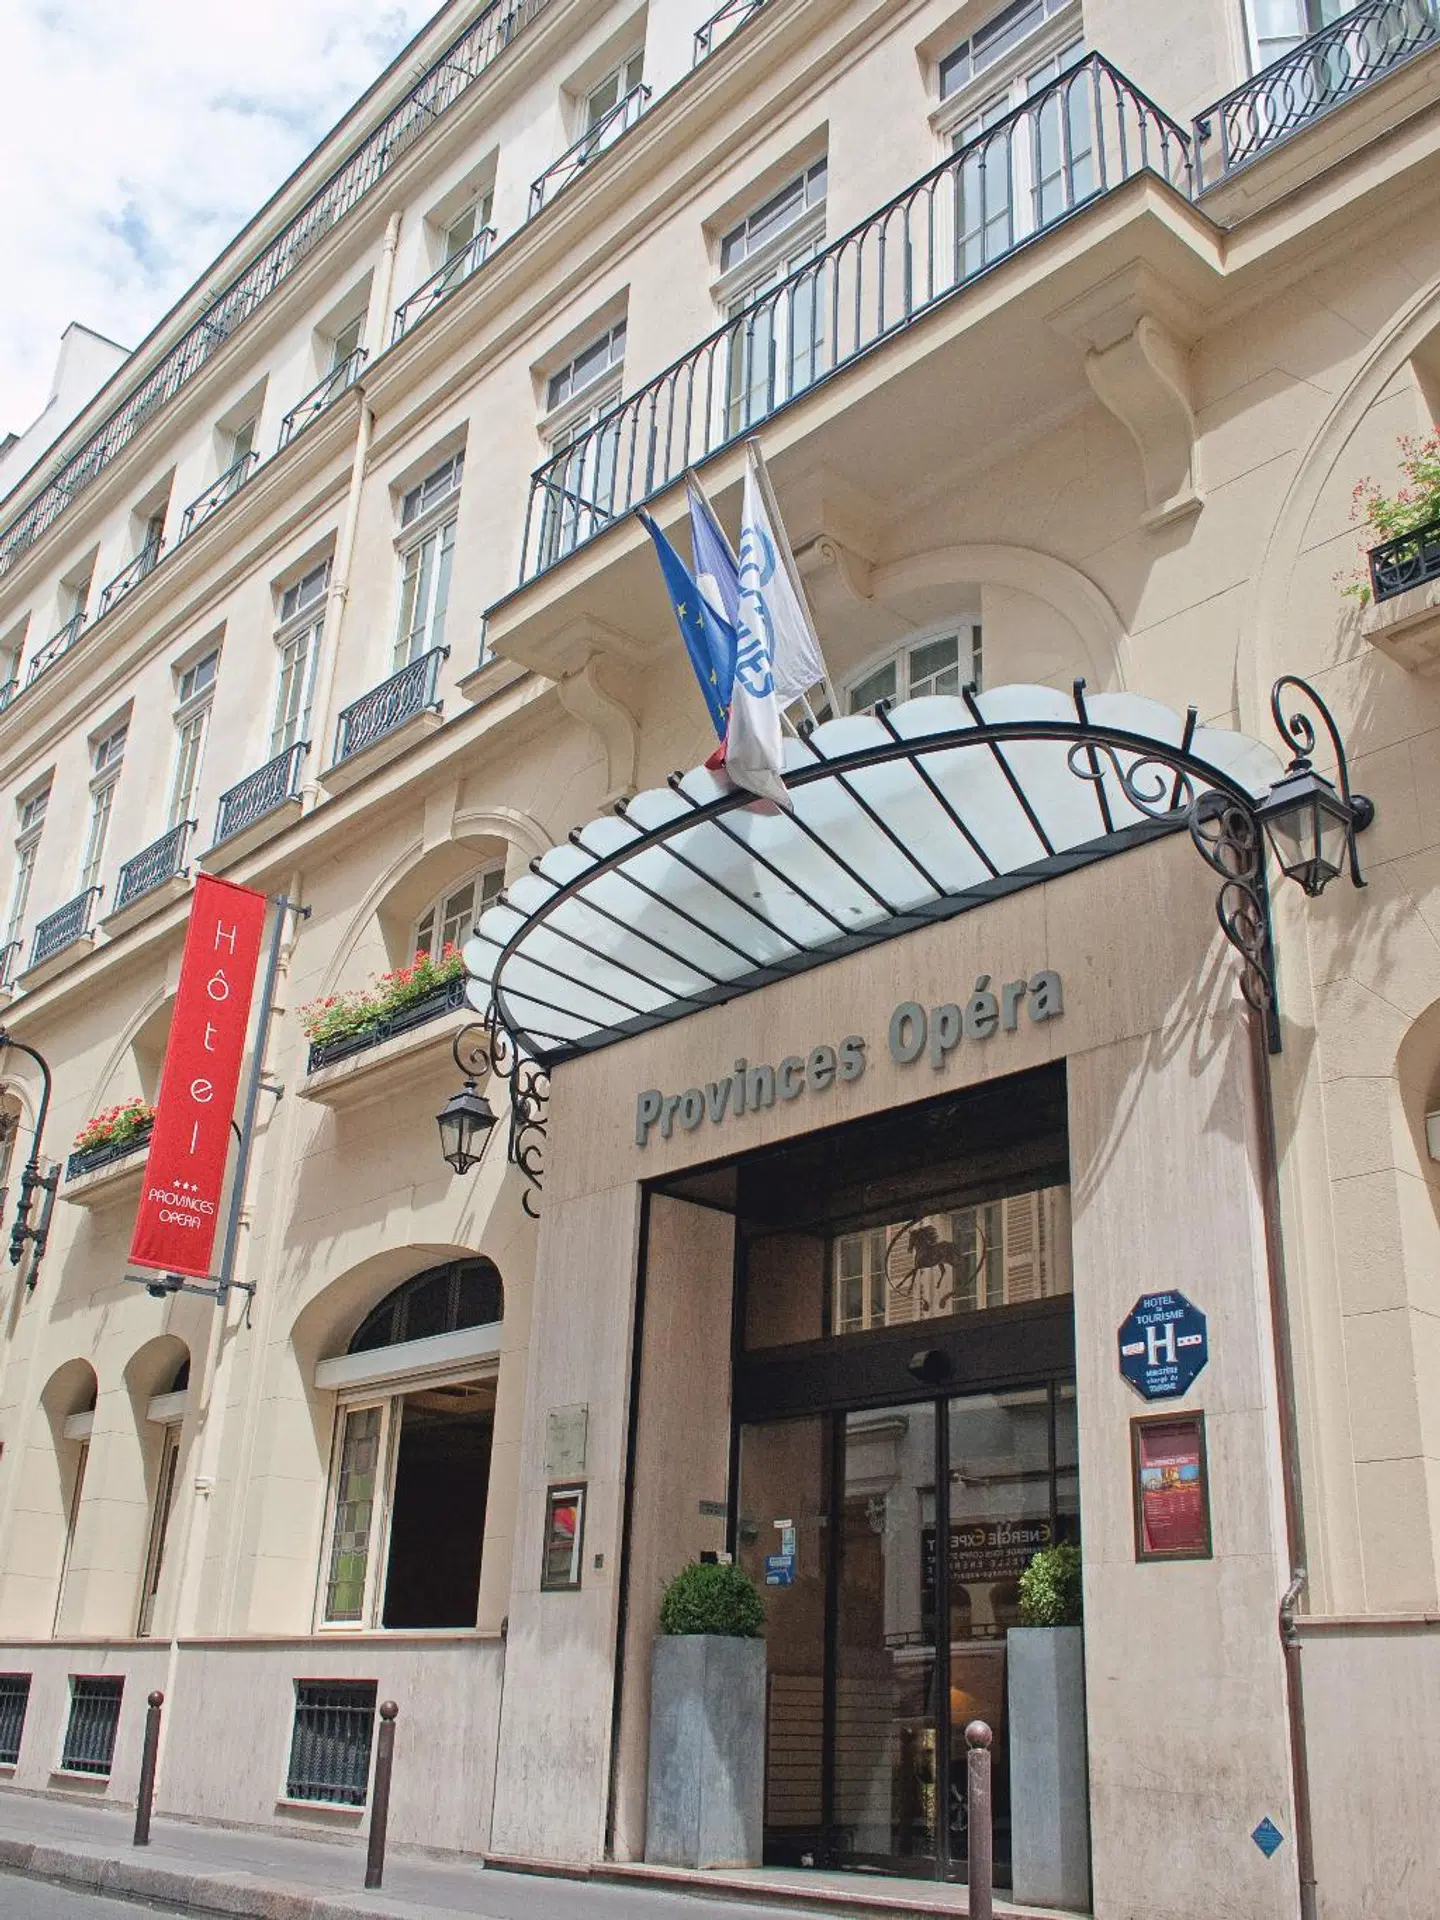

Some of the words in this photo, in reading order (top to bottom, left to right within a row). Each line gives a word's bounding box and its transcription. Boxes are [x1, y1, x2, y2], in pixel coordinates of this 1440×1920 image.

[189, 919, 238, 1155] Hôtel
[635, 1034, 866, 1146] Provinces
[889, 970, 1065, 1069] Opéra
[149, 1188, 214, 1214] PROVINCES
[159, 1209, 201, 1230] OPERA
[1143, 1295, 1176, 1308] HOTEL
[1136, 1309, 1185, 1324] TOURISME
[1145, 1322, 1178, 1365] H
